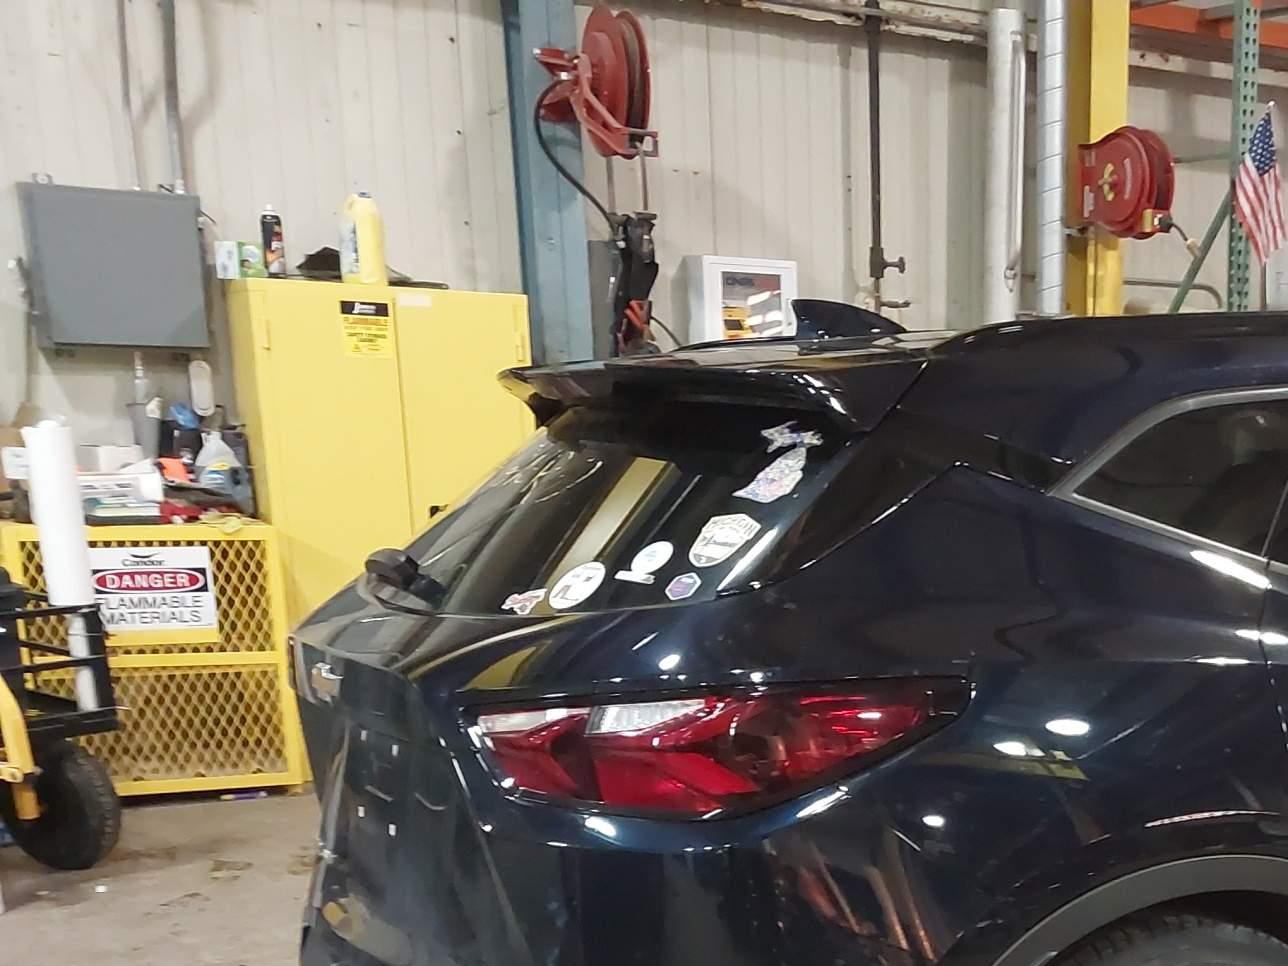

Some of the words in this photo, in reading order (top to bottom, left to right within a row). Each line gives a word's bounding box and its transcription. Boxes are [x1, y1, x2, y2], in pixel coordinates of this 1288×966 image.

[105, 573, 190, 589] DANGER
[95, 595, 204, 610] FLAMMABLE
[99, 610, 202, 625] MATERIALS
